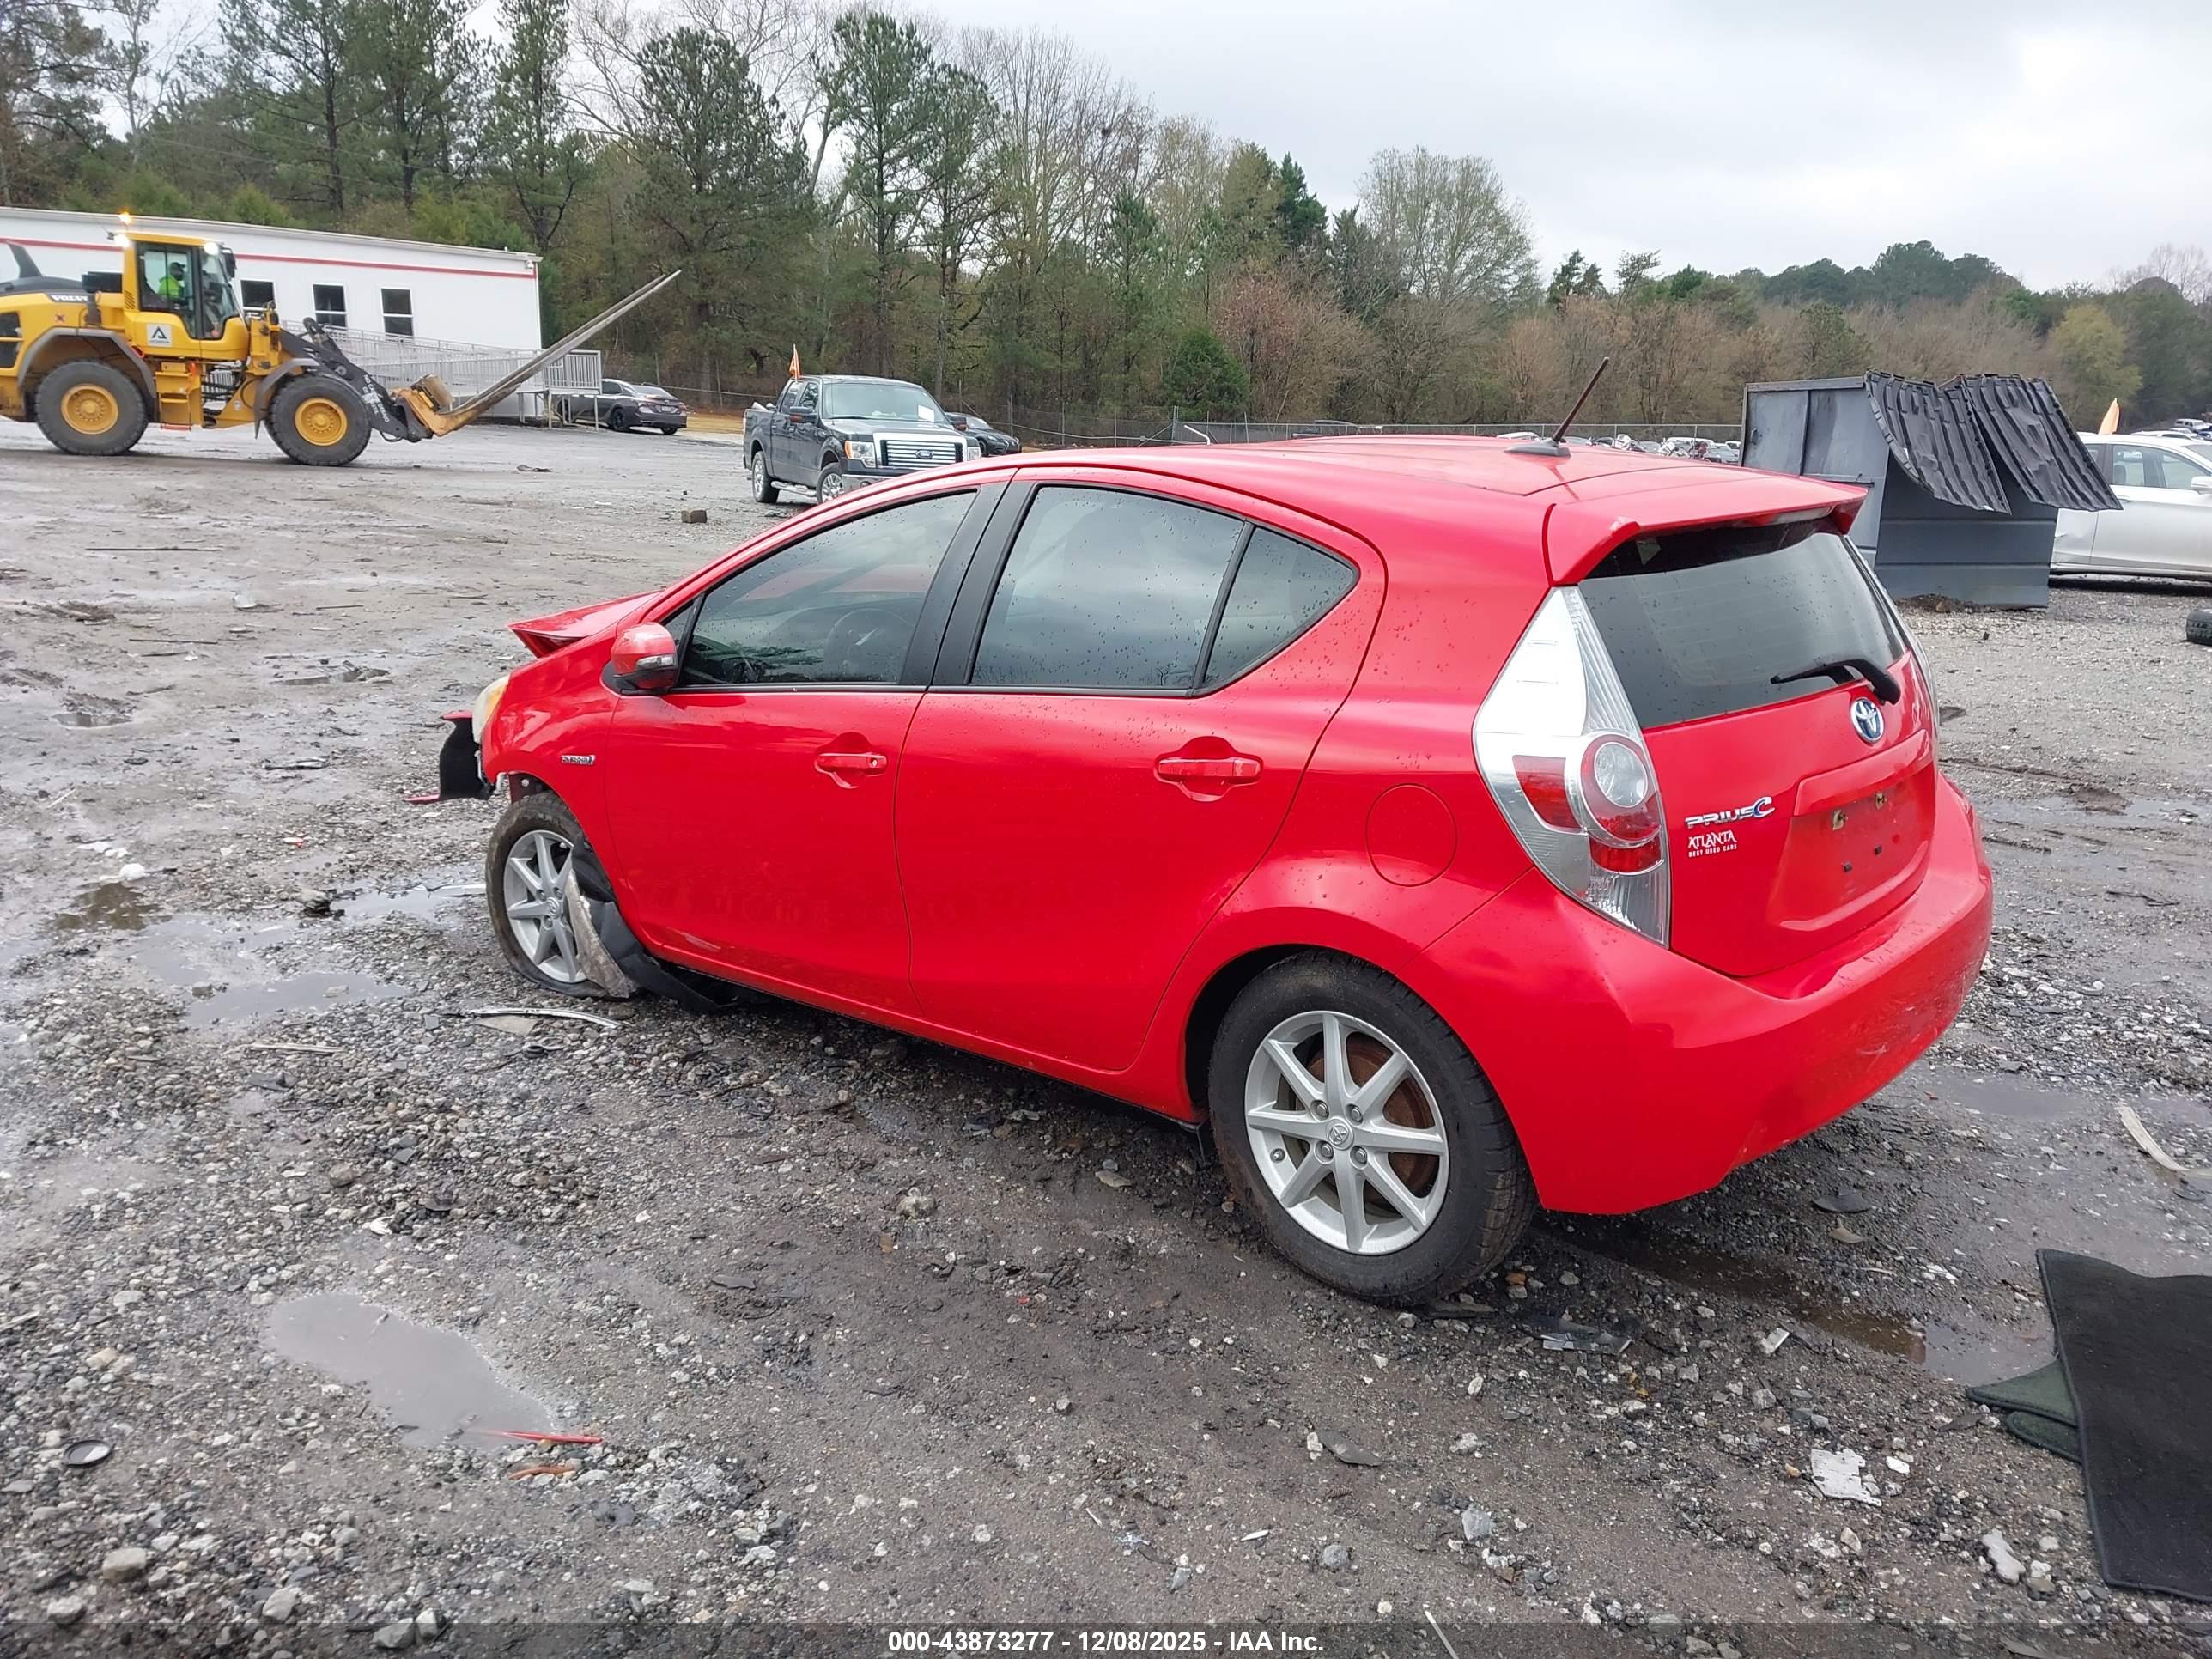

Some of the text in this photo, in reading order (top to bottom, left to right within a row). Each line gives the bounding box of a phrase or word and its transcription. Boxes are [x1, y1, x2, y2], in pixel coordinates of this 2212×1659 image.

[1688, 830, 1737, 848] ATLANTA
[1688, 843, 1738, 858] BEST USED CARS
